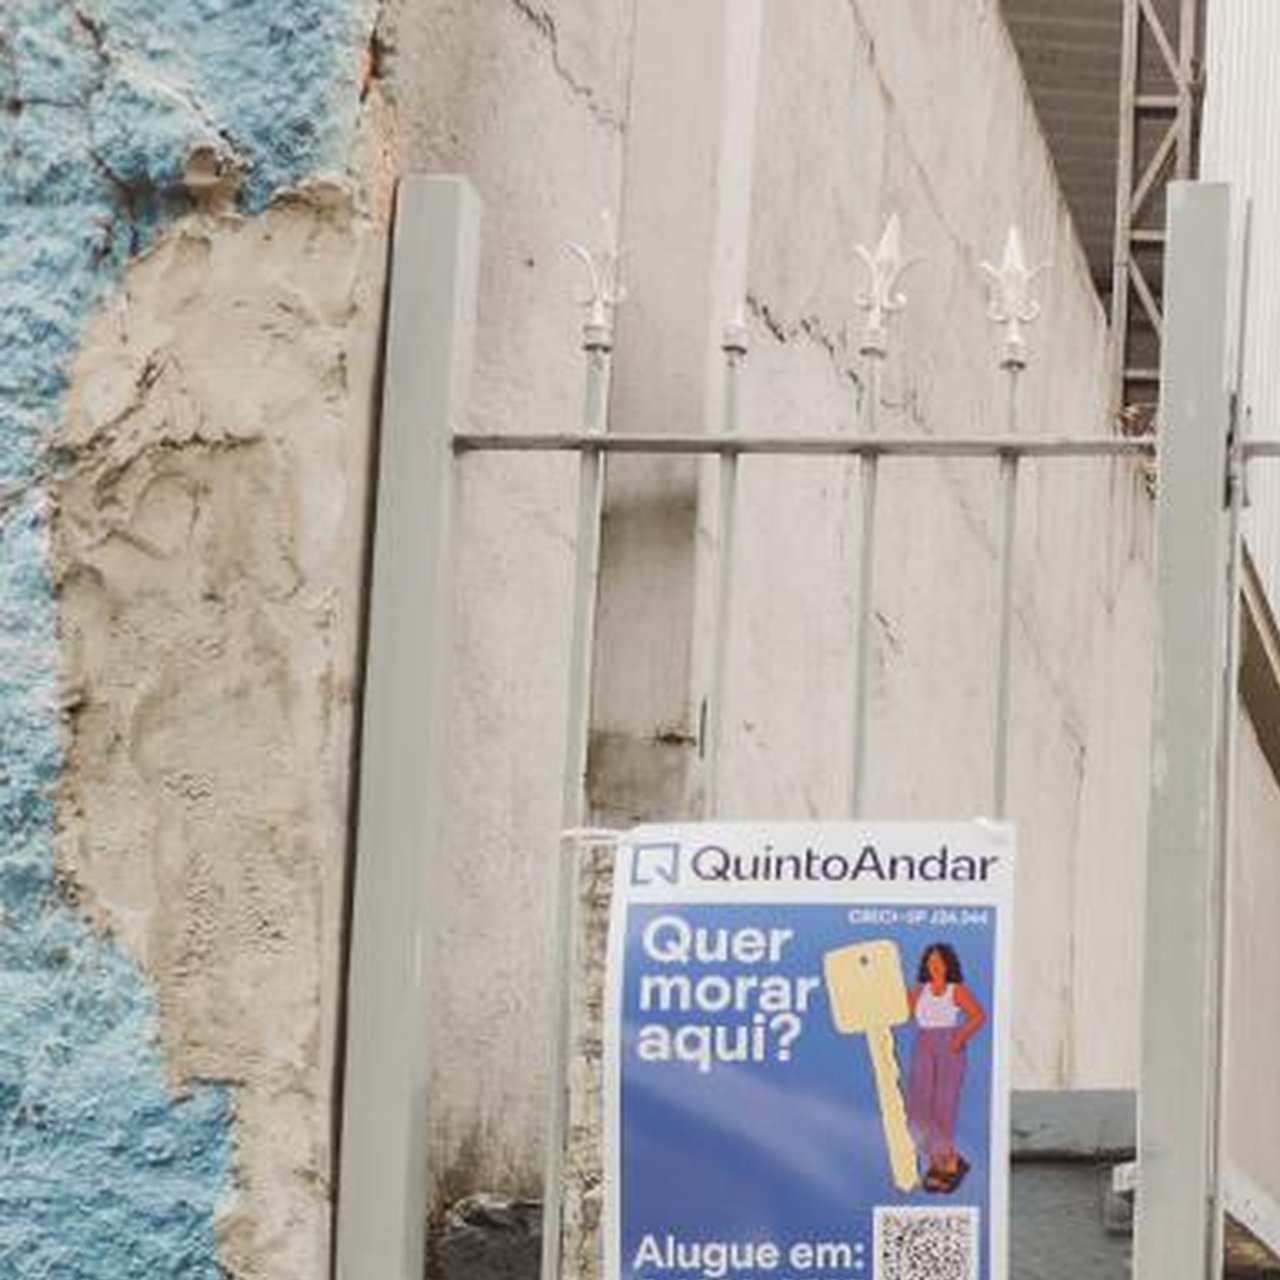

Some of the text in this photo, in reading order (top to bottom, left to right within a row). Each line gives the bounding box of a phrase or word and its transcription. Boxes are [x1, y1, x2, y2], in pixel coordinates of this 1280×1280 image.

[691, 845, 999, 882] QuintoAndar
[642, 915, 794, 963] Quer
[639, 975, 821, 1012] morar
[638, 1012, 801, 1072] aqui?
[633, 1234, 865, 1278] Alugue em:
